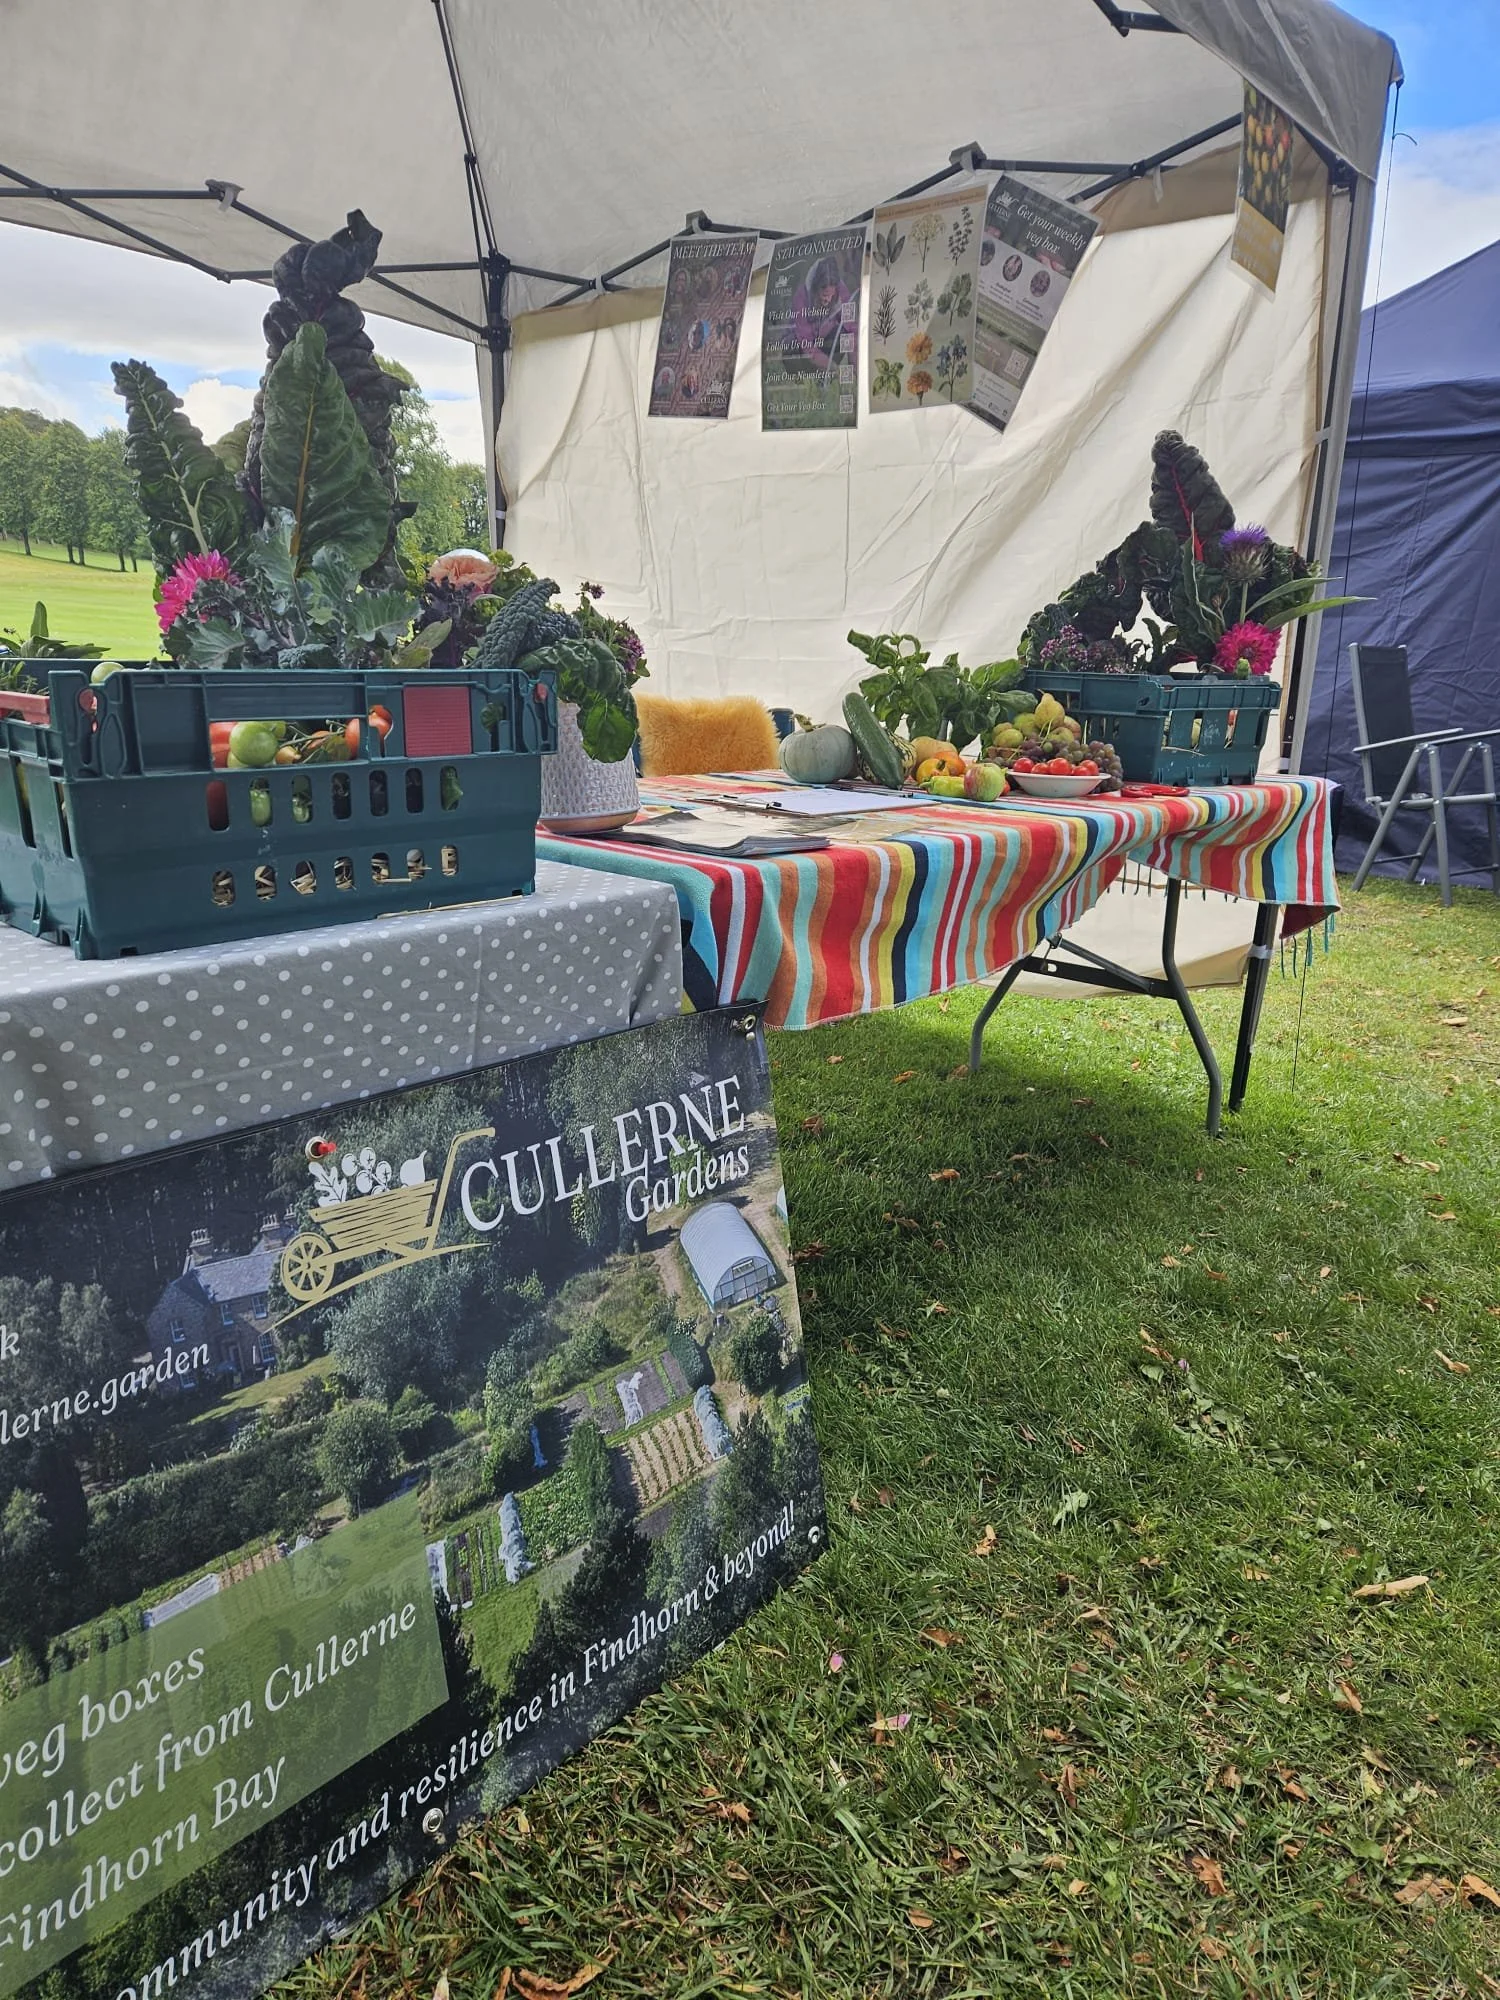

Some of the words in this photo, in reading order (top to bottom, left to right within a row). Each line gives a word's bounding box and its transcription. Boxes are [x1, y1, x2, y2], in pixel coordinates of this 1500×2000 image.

[673, 245, 702, 259] MEET
[703, 244, 723, 257] THE
[723, 242, 755, 256] TEAM
[776, 246, 796, 261] STAY
[796, 235, 863, 256] CONNECTED
[1017, 204, 1033, 220] Get
[1030, 215, 1054, 231] your
[1054, 226, 1086, 251] weekly
[1026, 231, 1042, 247] veg
[1041, 236, 1060, 254] box
[768, 310, 784, 320] Visit
[785, 309, 800, 319] Our
[801, 306, 829, 318] Website
[766, 340, 790, 352] Follow
[791, 339, 801, 350] Us
[801, 338, 812, 349] On
[766, 372, 781, 383] Join
[781, 371, 797, 381] Our
[796, 369, 836, 381] Newsletter
[766, 402, 779, 413] Get
[780, 401, 798, 412] Your
[799, 401, 811, 413] Veg
[812, 400, 826, 410] Box
[461, 1075, 745, 1231] CULLERNE
[625, 1143, 750, 1223] Gardens
[0, 1343, 210, 1445] lerne.garden
[79, 1647, 205, 1741] boxes
[326, 1792, 391, 1870] and
[399, 1694, 543, 1818] resilience
[550, 1671, 578, 1709] in
[583, 1587, 700, 1686] Findhorn
[704, 1566, 720, 1601] &
[724, 1501, 796, 1583] beyond!
[0, 1761, 144, 1877] collect
[155, 1702, 254, 1792] from
[264, 1602, 417, 1712] Cullerne
[211, 1756, 286, 1830] Bay
